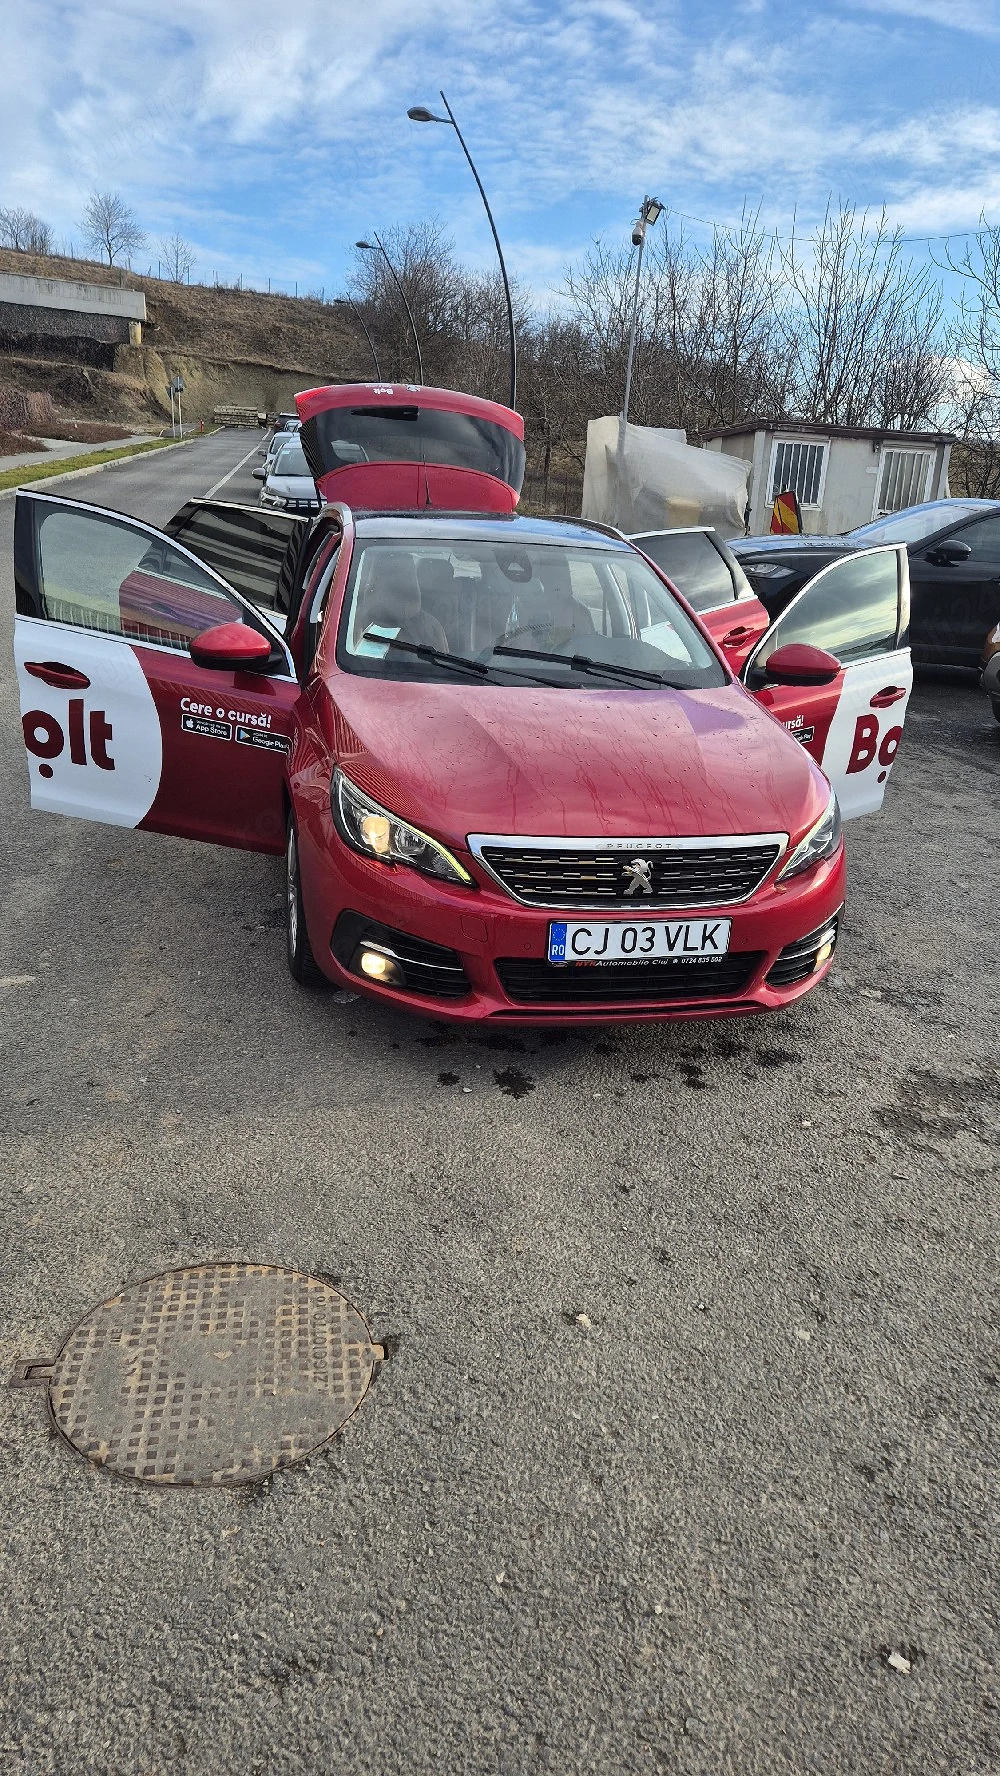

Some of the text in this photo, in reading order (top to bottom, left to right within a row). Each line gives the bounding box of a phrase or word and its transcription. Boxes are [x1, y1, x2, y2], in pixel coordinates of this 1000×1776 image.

[180, 697, 213, 717] Cere
[216, 707, 225, 719] o
[228, 712, 272, 729] cursă!
[195, 724, 210, 733] App
[210, 726, 228, 736] Store
[252, 736, 275, 748] Google
[551, 923, 722, 956] RO CJ 03 VLK
